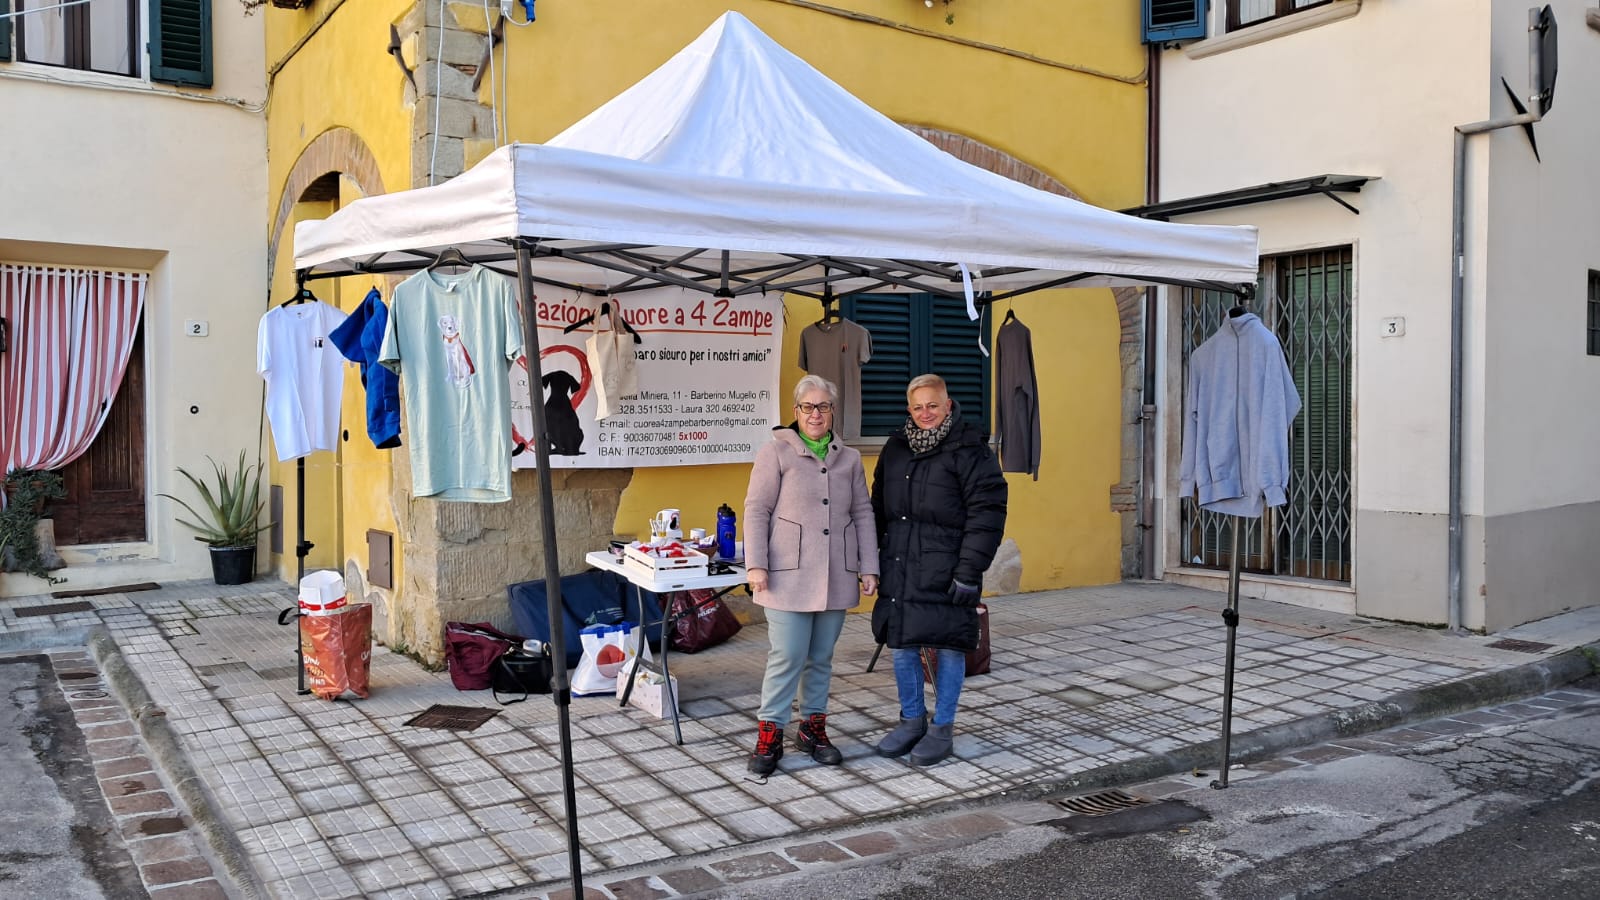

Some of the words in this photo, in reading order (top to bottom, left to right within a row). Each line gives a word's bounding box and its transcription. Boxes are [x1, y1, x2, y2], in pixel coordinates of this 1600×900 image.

[612, 298, 669, 327] uore
[675, 307, 685, 326] a
[691, 299, 707, 326] 4
[713, 299, 773, 336] Zampe
[193, 323, 201, 334] 2
[1389, 322, 1396, 333] 3
[659, 347, 687, 361] sicuro
[690, 349, 705, 365] per
[713, 348, 740, 361] nostri
[640, 390, 670, 401] Miniera,
[673, 390, 681, 400] 11
[690, 390, 727, 400] Barberino
[728, 390, 757, 402] Mugello
[758, 390, 771, 401] (FI)
[681, 404, 703, 414] Laura
[705, 404, 720, 413] 320
[722, 403, 756, 413] 4692402
[599, 419, 631, 429] E-mail:
[678, 431, 708, 441] 5x1000
[598, 446, 625, 457] IBAN:
[627, 443, 752, 457] IT42T0306909606100000403309
